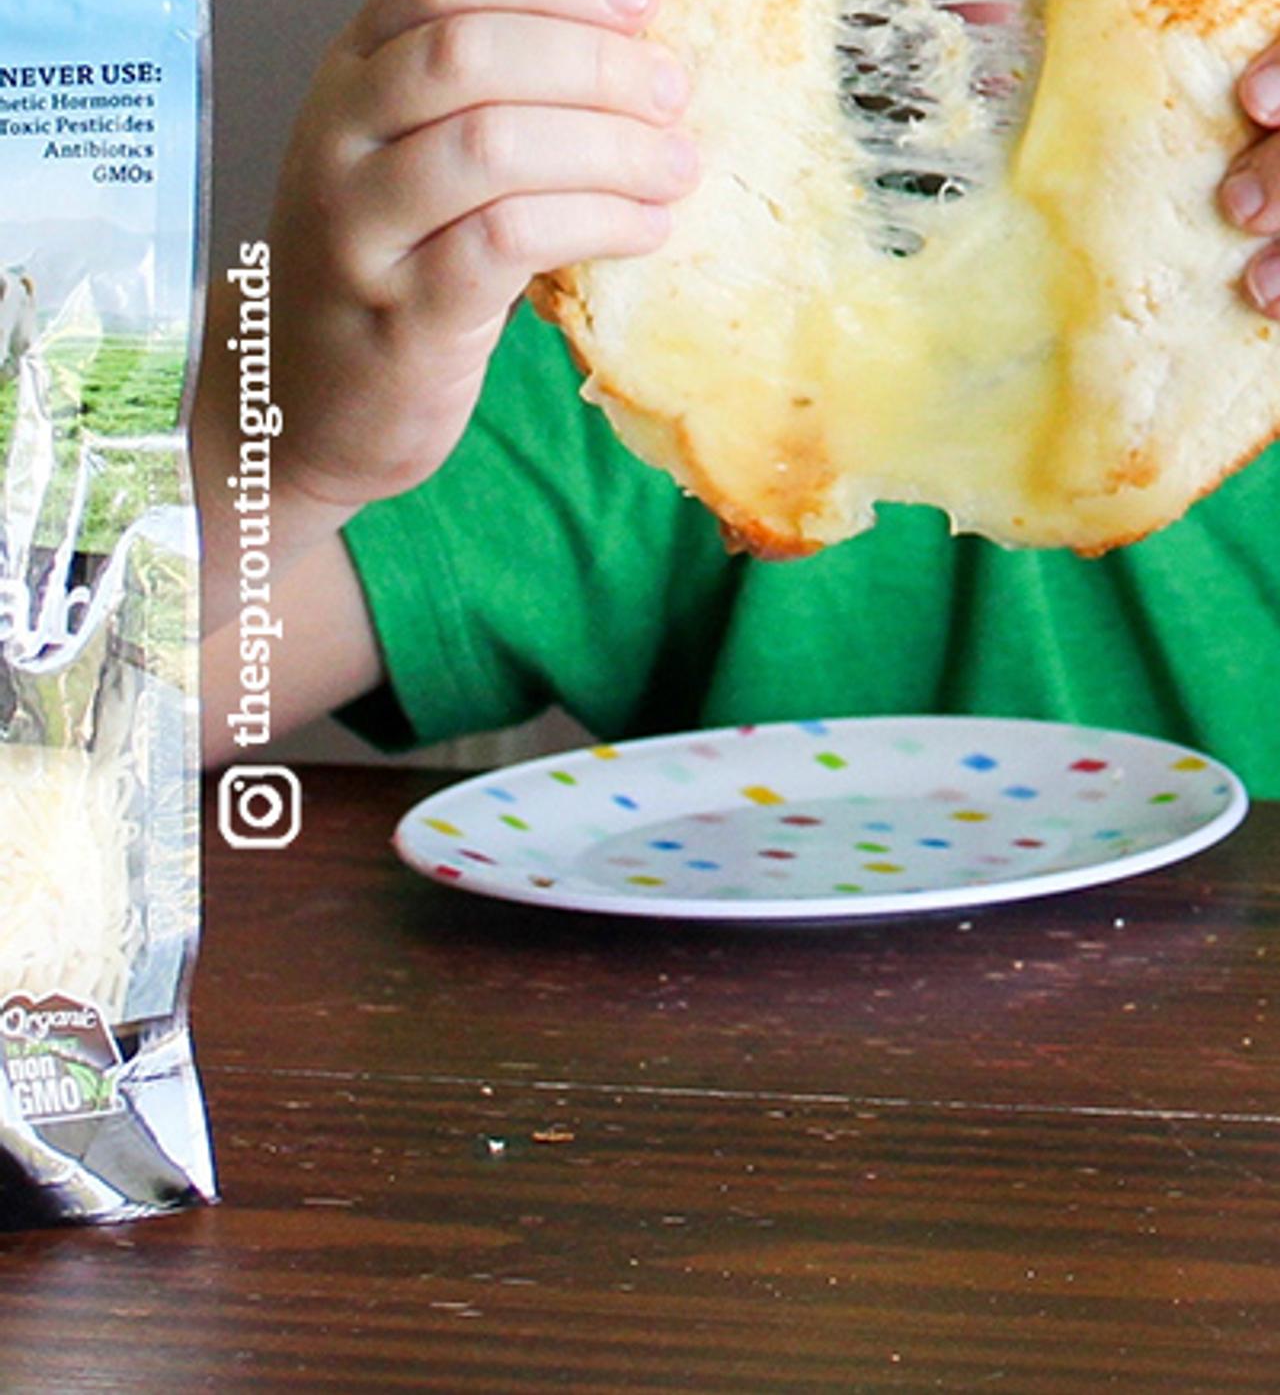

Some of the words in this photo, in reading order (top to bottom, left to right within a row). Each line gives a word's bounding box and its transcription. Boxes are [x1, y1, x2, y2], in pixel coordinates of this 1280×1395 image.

[0, 65, 94, 87] NEVER
[101, 63, 162, 84] USE:
[51, 93, 155, 110] Hormones
[0, 117, 51, 136] Toxic
[56, 116, 154, 133] Pesticides
[43, 141, 155, 159] Antibiotics
[92, 166, 153, 183] GMOs
[3, 1006, 98, 1039] Organic
[9, 1056, 55, 1081] non
[13, 1075, 81, 1114] GMO
